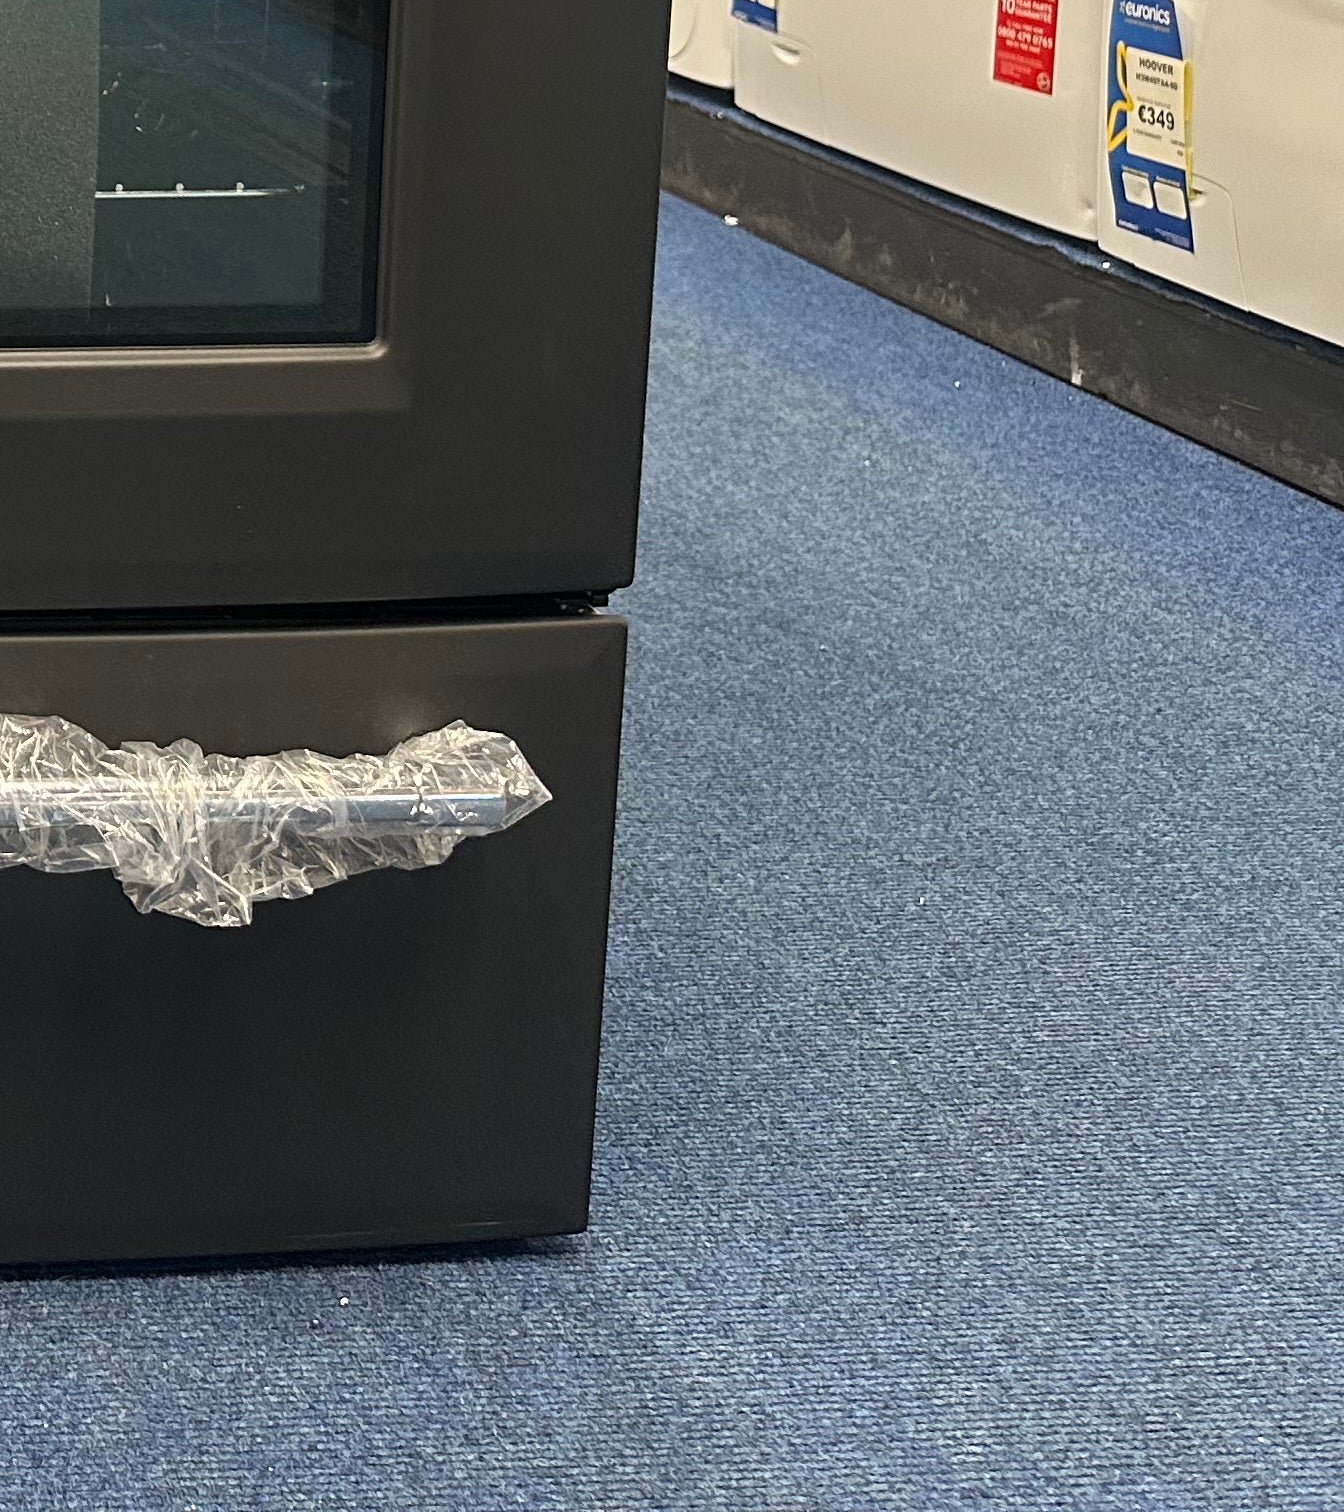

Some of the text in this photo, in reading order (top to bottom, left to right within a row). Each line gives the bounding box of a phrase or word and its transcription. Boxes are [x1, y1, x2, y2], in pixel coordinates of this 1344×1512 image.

[1125, 1, 1171, 26] euronics
[1139, 57, 1174, 76] HOOVER
[1138, 105, 1175, 131] €349
